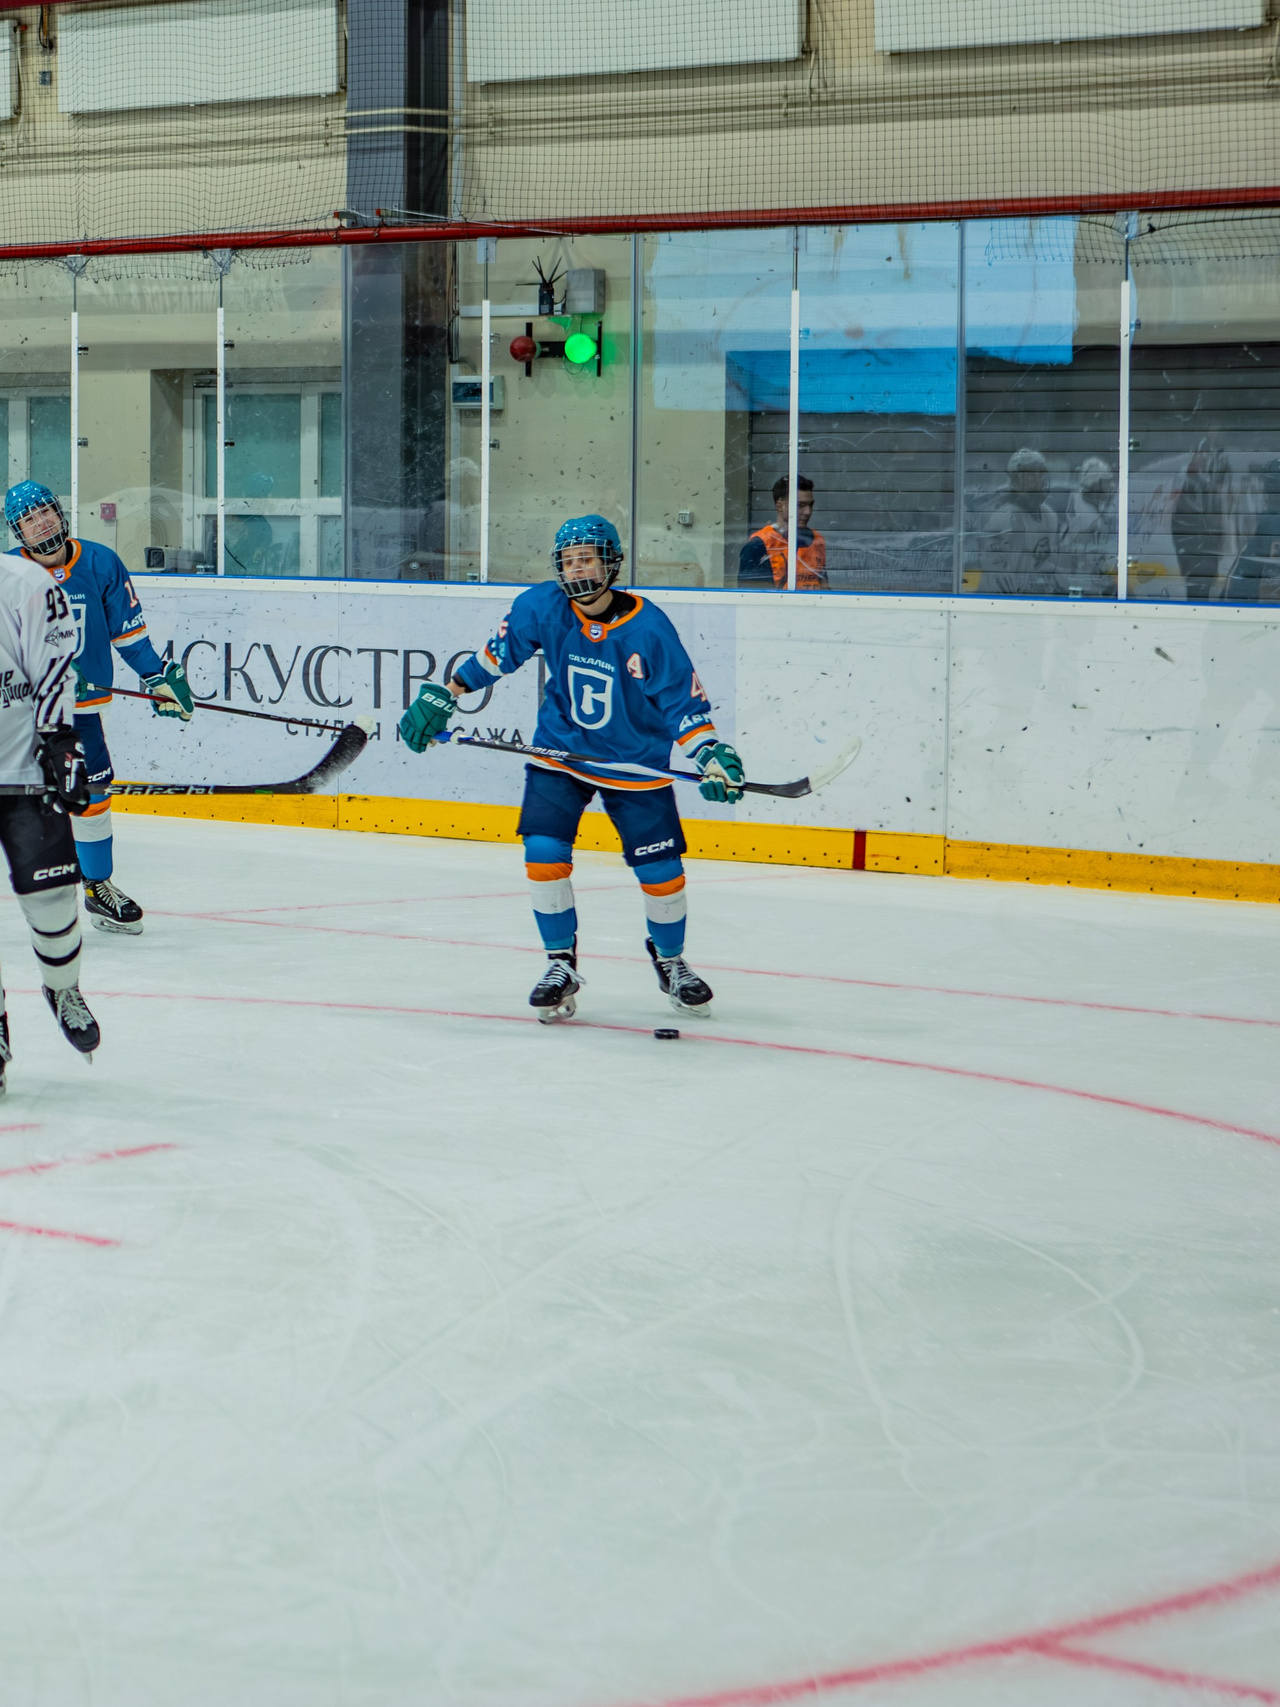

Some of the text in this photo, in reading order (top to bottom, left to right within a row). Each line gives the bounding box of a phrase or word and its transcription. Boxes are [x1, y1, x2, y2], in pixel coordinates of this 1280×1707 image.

[45, 585, 69, 622] 93
[568, 653, 615, 673] САХАЛИН
[633, 838, 675, 857] CCM
[32, 863, 78, 881] CCM
